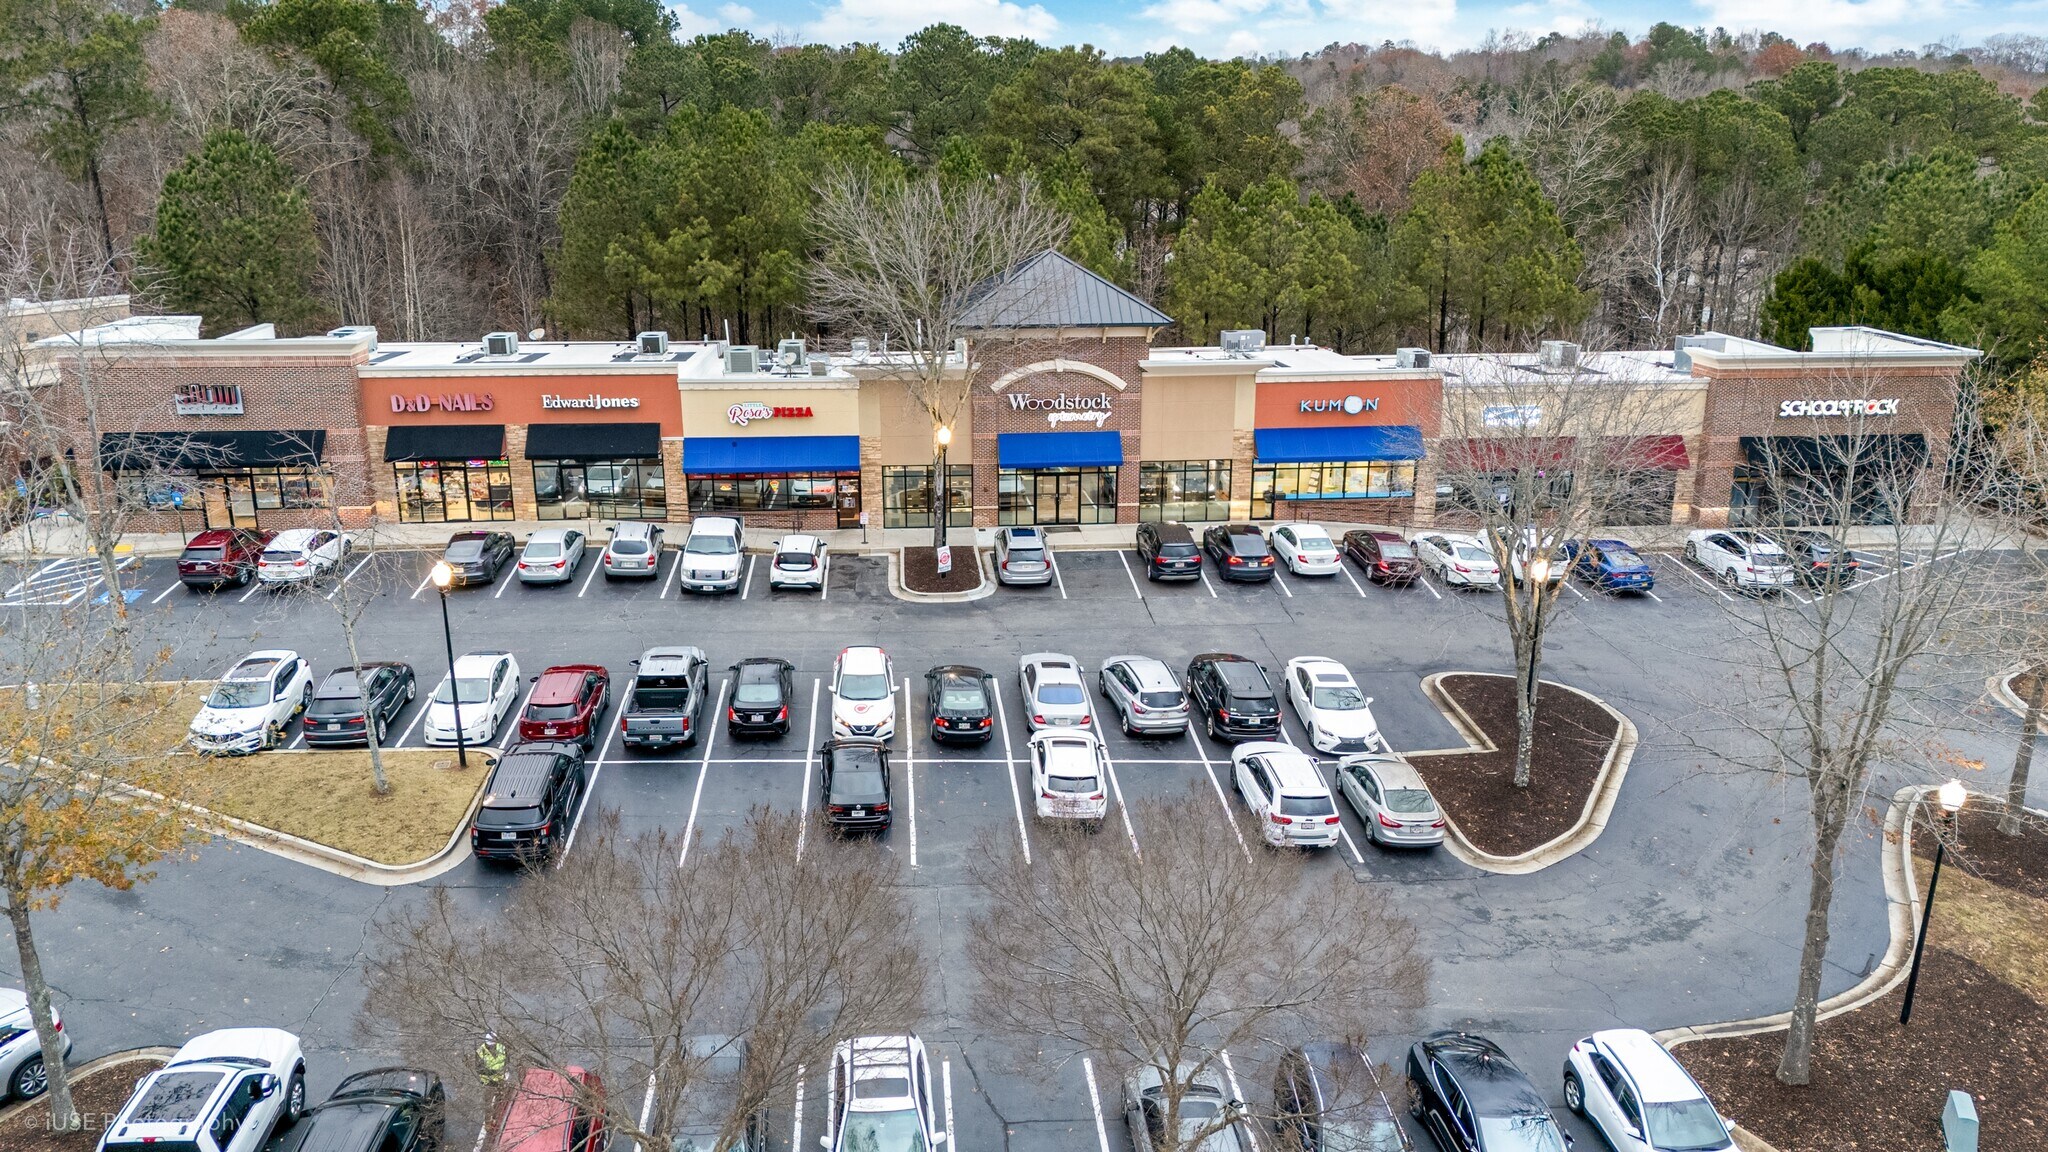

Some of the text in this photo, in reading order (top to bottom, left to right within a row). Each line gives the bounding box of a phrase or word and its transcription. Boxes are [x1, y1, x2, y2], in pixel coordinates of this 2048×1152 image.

[390, 392, 494, 412] D&D NAILS
[1007, 393, 1112, 410] Woodstock
[1300, 395, 1379, 414] KUMON
[1779, 400, 1840, 416] SCHOOL
[728, 404, 813, 426] Rosa's PIZZA
